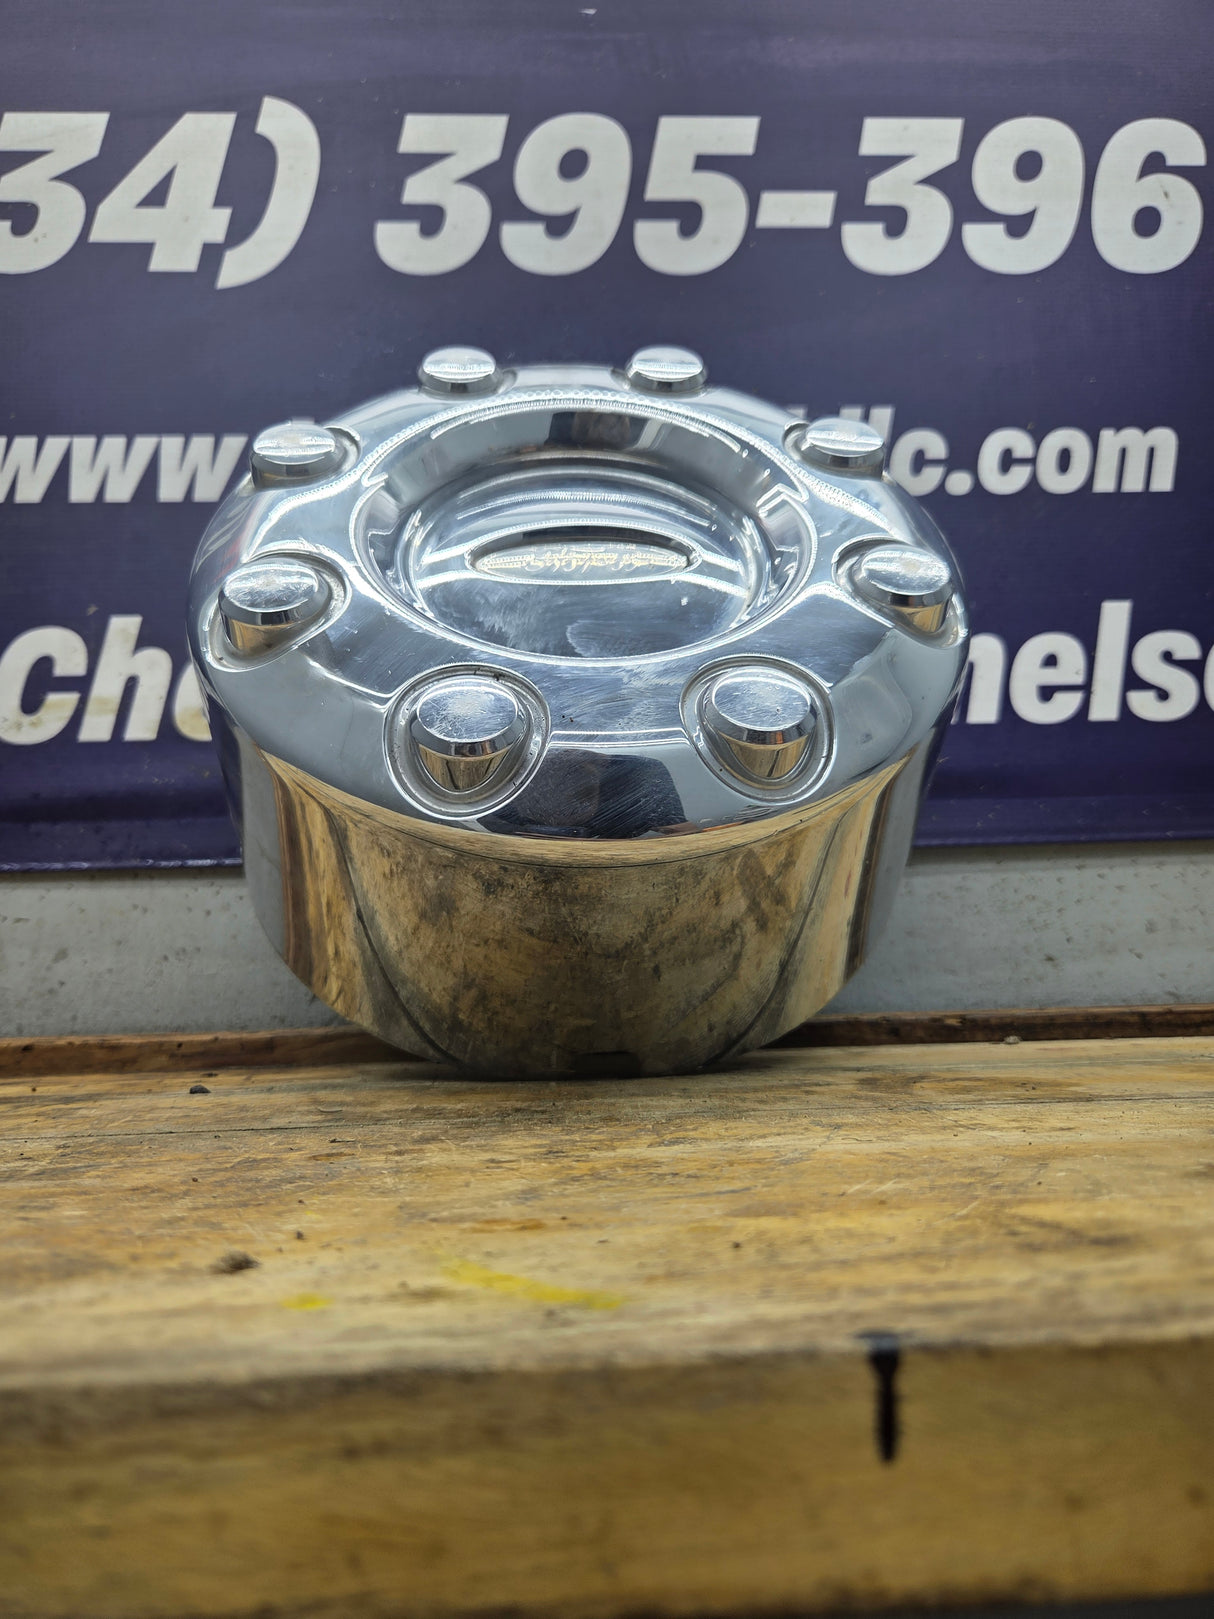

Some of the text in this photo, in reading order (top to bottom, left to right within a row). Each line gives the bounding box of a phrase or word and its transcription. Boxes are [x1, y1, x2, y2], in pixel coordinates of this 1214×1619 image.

[374, 111, 1208, 276] 395-396
[785, 404, 1179, 497] c.com
[951, 599, 1214, 725] nels
